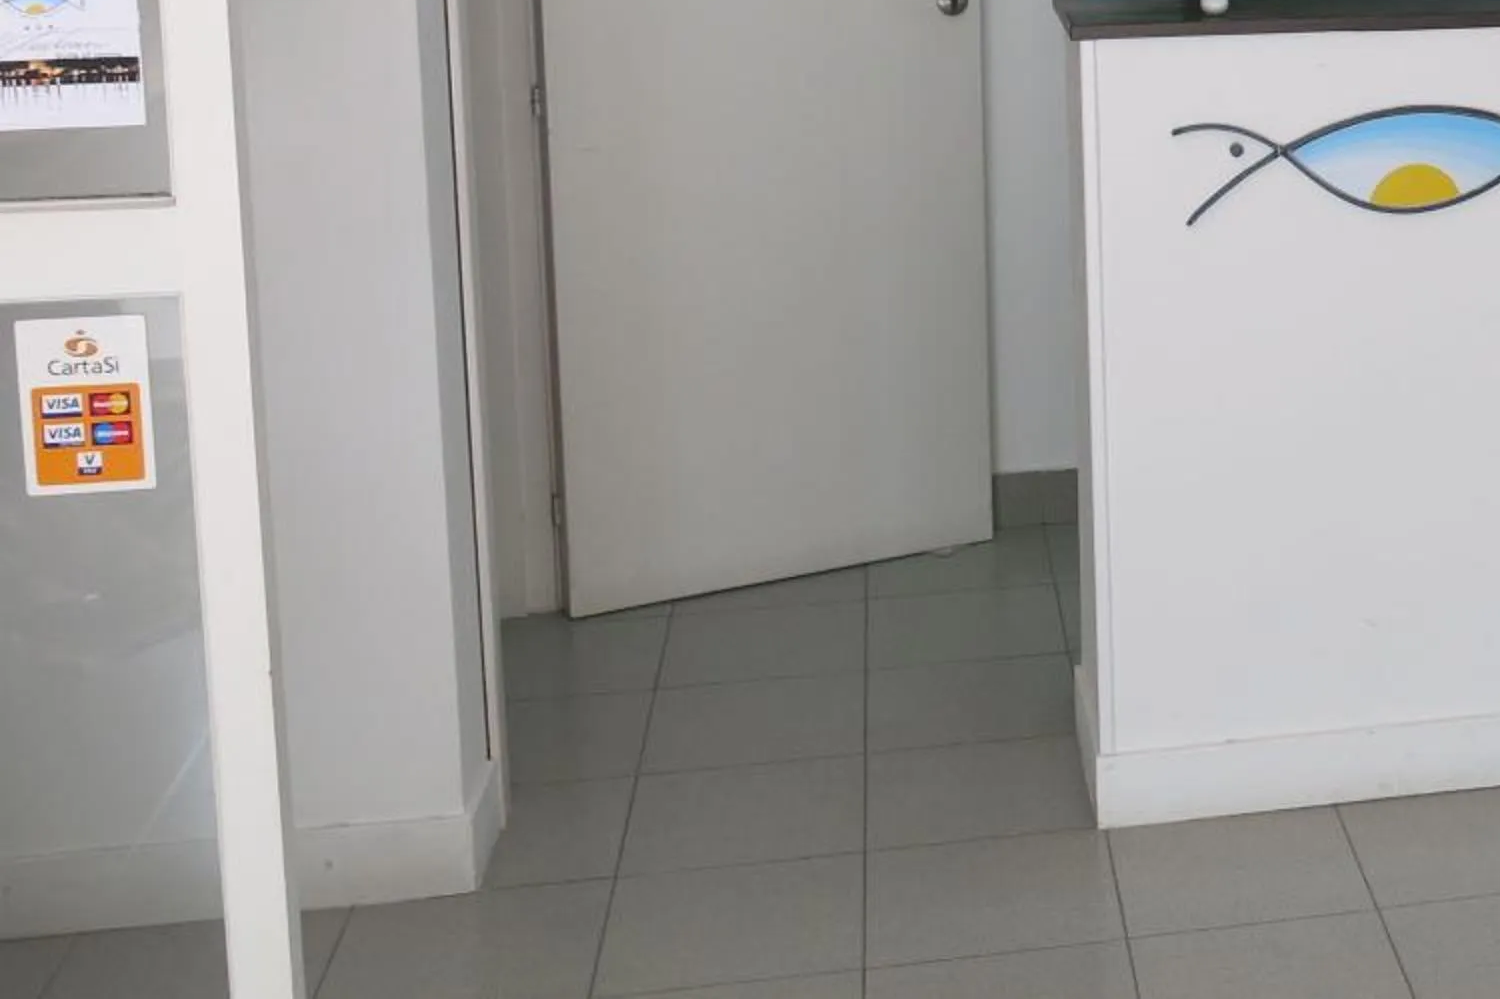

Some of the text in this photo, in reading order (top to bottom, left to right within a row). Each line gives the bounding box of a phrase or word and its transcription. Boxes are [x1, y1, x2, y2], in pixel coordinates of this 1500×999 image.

[47, 356, 120, 376] CartaSi
[46, 396, 80, 410] VISA
[48, 426, 82, 440] VISA
[85, 454, 95, 466] V
